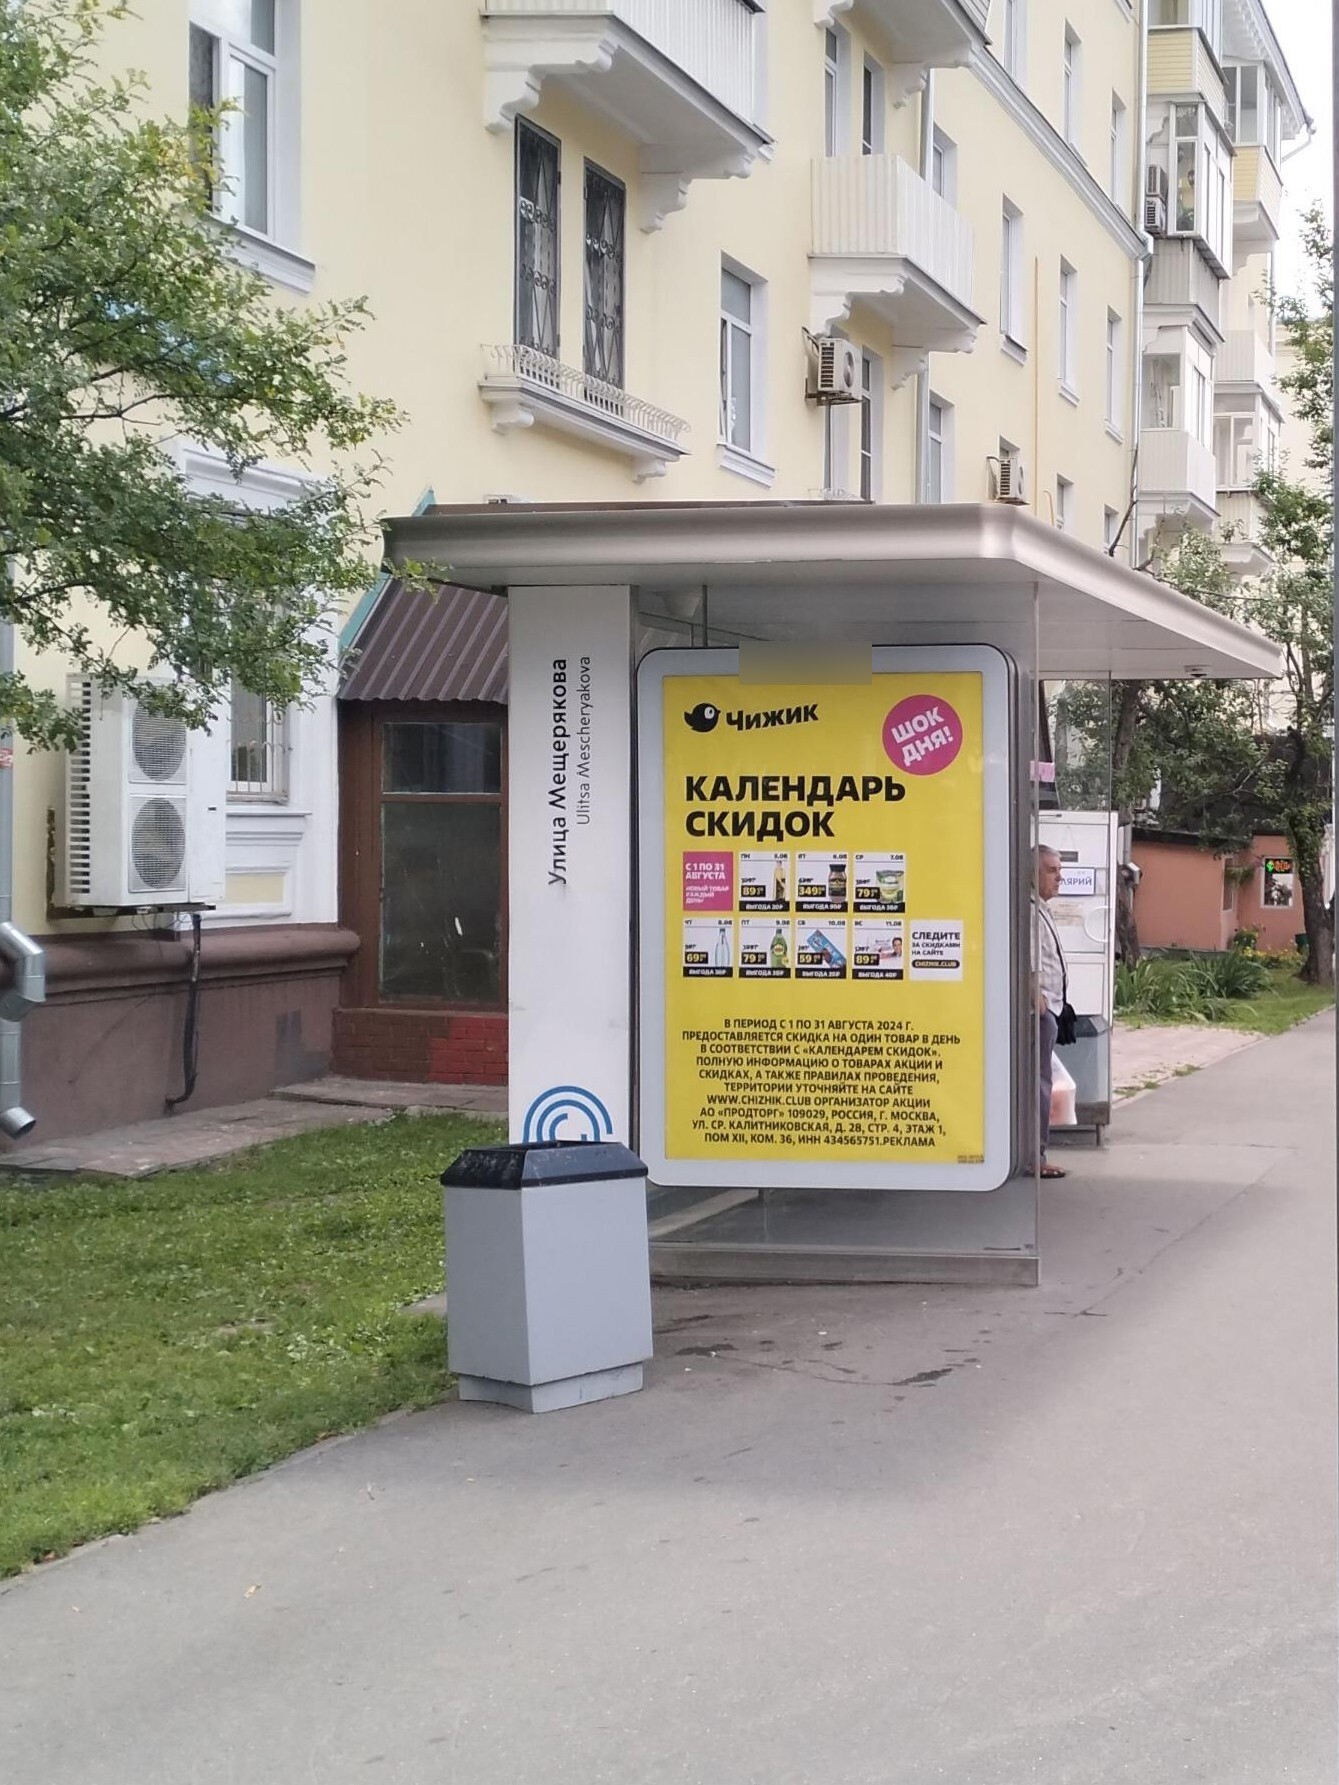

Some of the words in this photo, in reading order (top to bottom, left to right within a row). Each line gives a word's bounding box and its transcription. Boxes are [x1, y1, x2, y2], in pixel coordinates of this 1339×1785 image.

[577, 656, 594, 778] Mescheryakova
[891, 706, 945, 744] ШОК
[548, 659, 570, 809] Мещерякова
[902, 725, 955, 767] ДНЯ!
[685, 776, 906, 807] КАЛЕНДАРЬ
[577, 783, 590, 825] Ulitsa
[685, 811, 835, 842] СКИДОК
[548, 817, 569, 885] Улица
[685, 863, 691, 871] С
[699, 863, 713, 871] ПО
[714, 863, 725, 871] 31
[685, 871, 726, 880] АВГУСТА
[1060, 876, 1092, 886] ЛЯРИЙ
[912, 932, 961, 941] СЛЕДИТЕ
[922, 949, 944, 957] САЙТЕ
[724, 1018, 731, 1028] В
[734, 1019, 777, 1030] ПЕРИОД
[780, 1019, 785, 1028] С
[789, 1019, 793, 1028] 1
[796, 1019, 811, 1029] ПО
[814, 1020, 825, 1029] 31
[828, 1020, 874, 1030] АВГУСТА
[877, 1021, 902, 1030] 2024
[905, 1021, 913, 1030] Г.
[682, 1031, 783, 1043] ПРЕДОСТАВЛЯЕТСЯ
[786, 1032, 829, 1043] СКИДКА
[833, 1033, 847, 1042] НА
[850, 1033, 881, 1044] ОДИН
[884, 1034, 919, 1043] ТОВАР
[922, 1034, 928, 1044] В
[931, 1034, 960, 1045] ДЕНЬ
[701, 1044, 707, 1053] В
[709, 1044, 790, 1054] СООТВЕТСТВИИ
[794, 1045, 799, 1055] С
[803, 1046, 883, 1057] «КАЛЕНДАРЕМ
[697, 1057, 743, 1067] ПОЛНУЮ
[746, 1058, 829, 1069] ИНФОРМАЦИЮ
[831, 1059, 839, 1068] О
[842, 1059, 890, 1069] ТОВАРАХ
[894, 1060, 932, 1071] АКЦИИ
[936, 1061, 942, 1070] И
[699, 1069, 752, 1080] СКИДКАХ,
[755, 1070, 762, 1079] А
[765, 1070, 800, 1080] ТАКЖЕ
[804, 1071, 860, 1081] ПРАВИЛАХ
[864, 1071, 939, 1083] ПРОВЕДЕНИЯ,
[724, 1082, 792, 1092] ТЕРРИТОРИИ
[796, 1081, 858, 1093] УТОЧНЯЙТЕ
[862, 1084, 876, 1094] НА
[880, 1083, 913, 1094] САЙТЕ
[707, 1095, 810, 1106] WWW.CHIZHIK.CLUB
[814, 1097, 889, 1107] ОРГАНИЗАТОР
[893, 1098, 930, 1109] АКЦИИ
[700, 1108, 715, 1117] АО
[718, 1108, 784, 1120] «ПРОДТОРГ»
[788, 1109, 828, 1120] 109029,
[832, 1110, 876, 1121] РОССИЯ,
[879, 1111, 887, 1120] Г.
[891, 1111, 939, 1122] МОСКВА,
[692, 1120, 708, 1129] УЛ.
[711, 1120, 726, 1129] СР.
[729, 1120, 832, 1132] КАЛИТНИКОВСКАЯ,
[835, 1122, 845, 1133] Д.
[849, 1122, 865, 1133] 28,
[868, 1123, 889, 1132] СТР.
[893, 1123, 902, 1134] 4,
[906, 1123, 934, 1133] ЭТАЖ
[939, 1124, 946, 1134] 1,
[705, 1133, 729, 1143] ПОМ
[751, 1134, 776, 1143] КОМ.
[781, 1134, 795, 1145] 36,
[798, 1134, 820, 1144] ИНН
